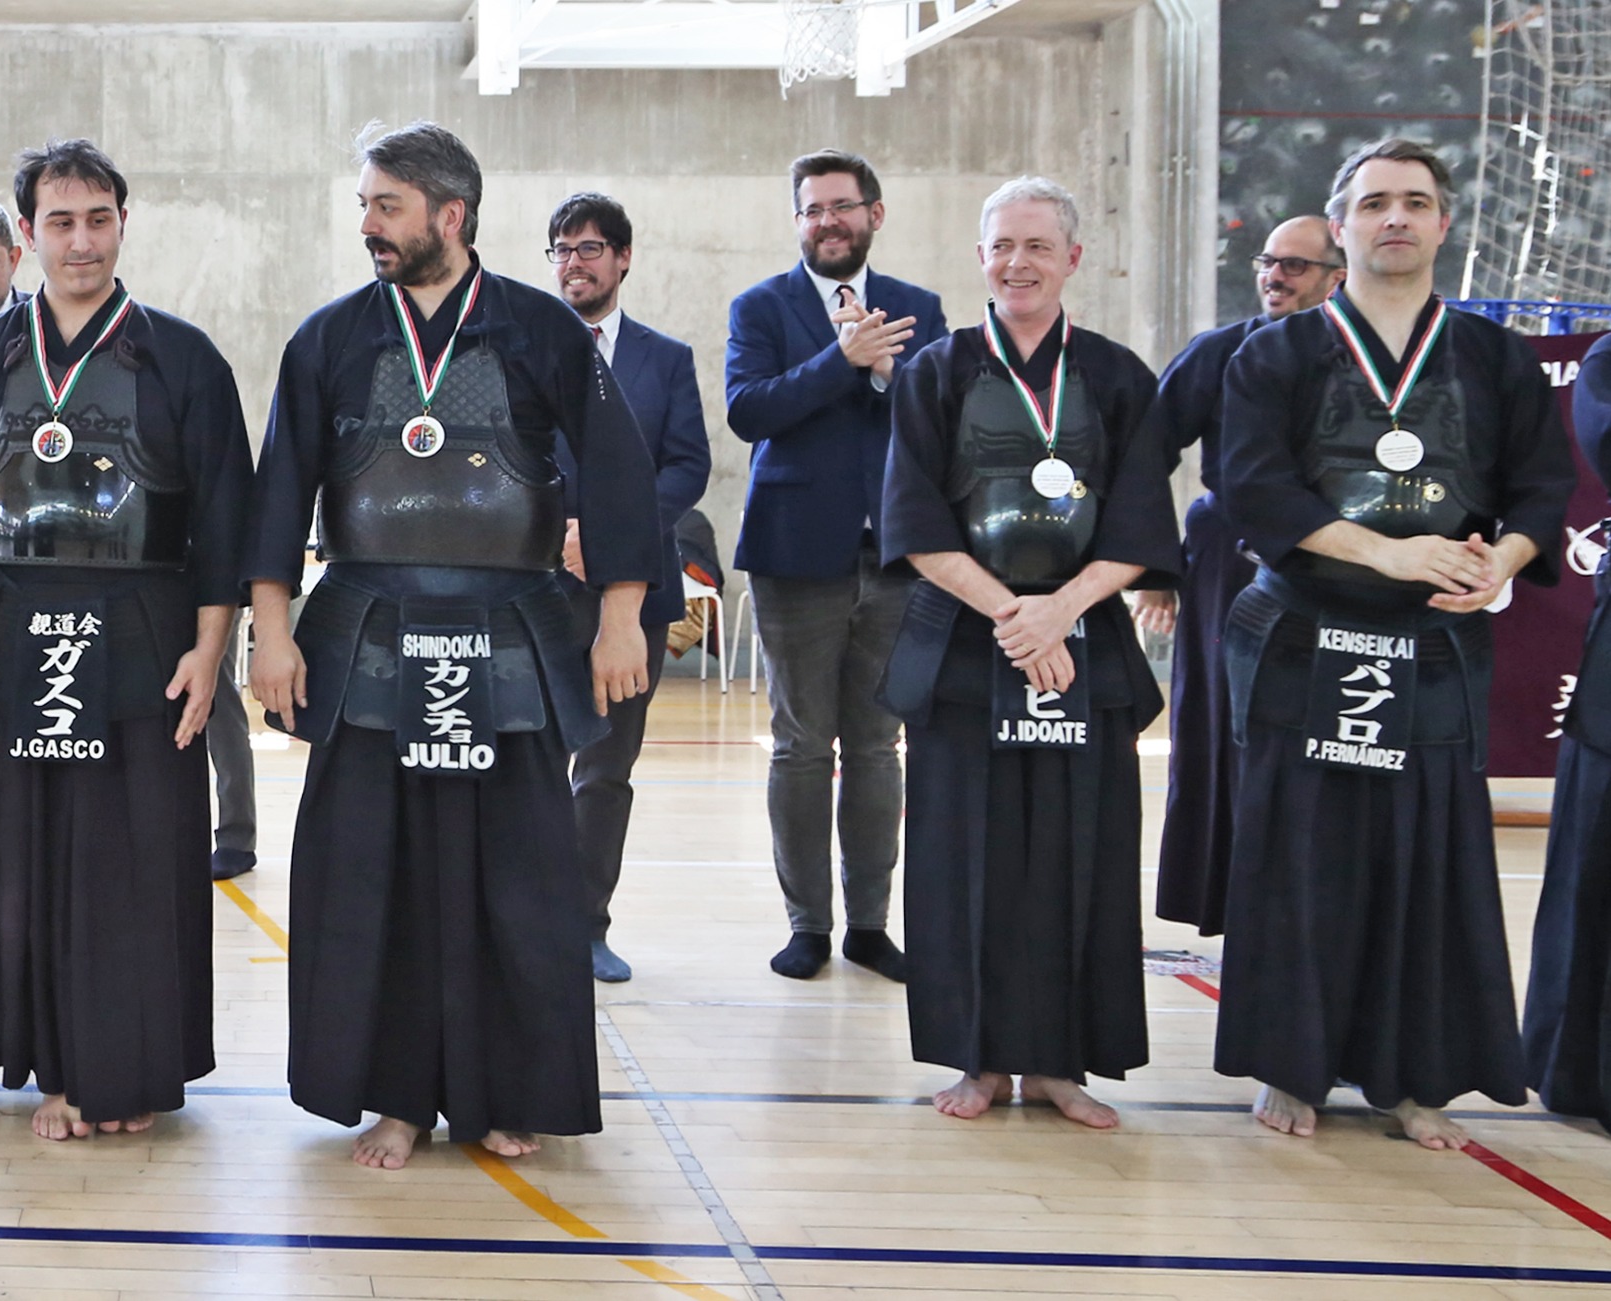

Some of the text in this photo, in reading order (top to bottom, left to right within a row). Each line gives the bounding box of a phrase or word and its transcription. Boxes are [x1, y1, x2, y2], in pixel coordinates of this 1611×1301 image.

[402, 633, 492, 659] SHINDOKAI
[1318, 627, 1415, 660] KENSEIKAI
[33, 638, 92, 736] ガスコ
[422, 659, 473, 743] カンチョ
[997, 719, 1087, 744] J.IDOATE
[9, 737, 105, 760] J.GASCO
[400, 742, 495, 770] JULIO
